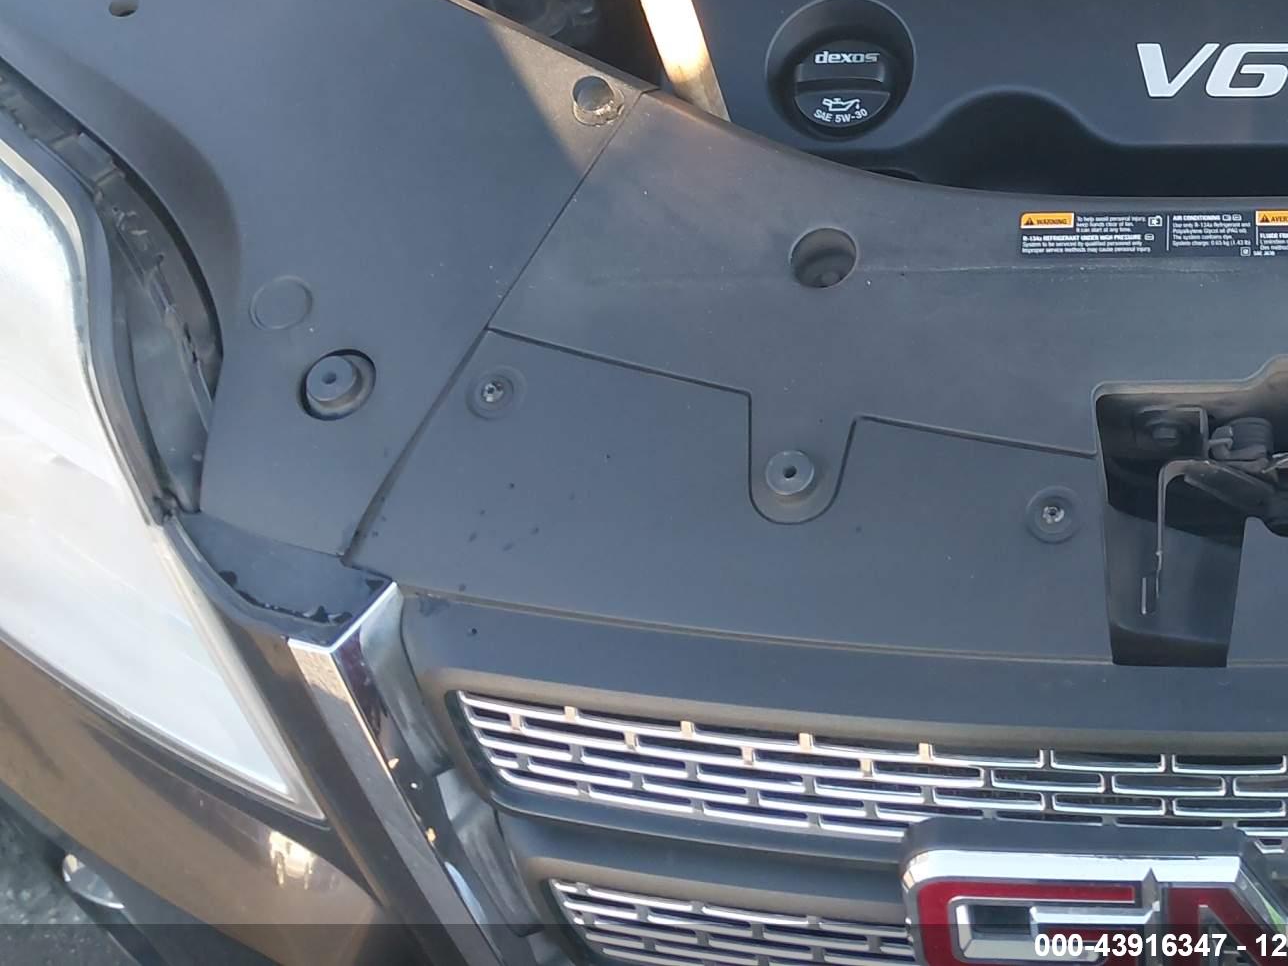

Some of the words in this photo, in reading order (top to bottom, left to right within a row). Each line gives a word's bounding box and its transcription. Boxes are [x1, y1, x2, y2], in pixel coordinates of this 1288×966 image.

[815, 50, 880, 64] dexos
[813, 109, 833, 122] SAE
[835, 108, 868, 123] 5W-30
